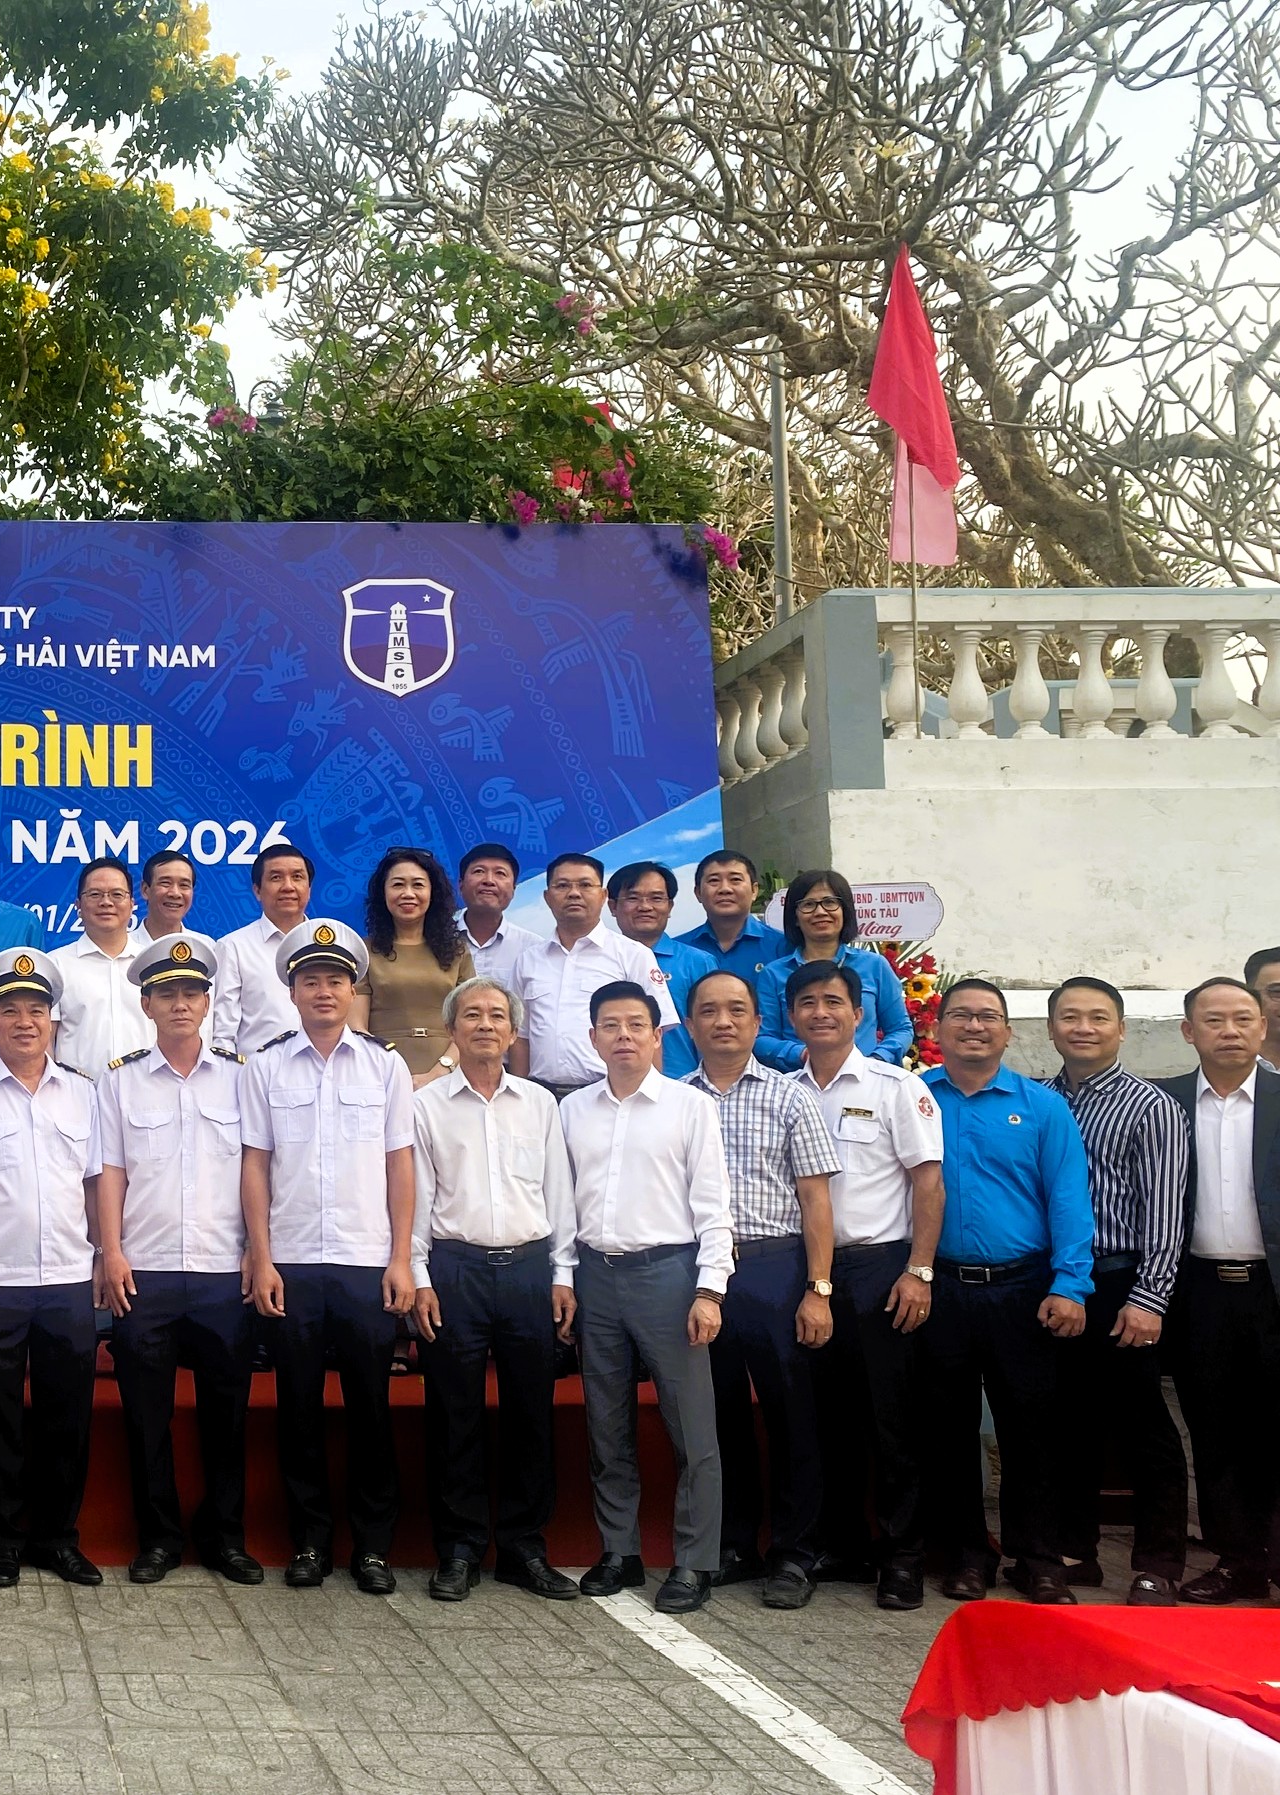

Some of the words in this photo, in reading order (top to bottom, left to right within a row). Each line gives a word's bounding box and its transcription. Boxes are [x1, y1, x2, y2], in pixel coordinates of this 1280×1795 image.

[0, 606, 37, 629] TY
[16, 636, 66, 667] HẢI
[75, 638, 140, 675] VIỆT
[148, 645, 216, 668] NAM
[12, 808, 139, 864] NĂM
[855, 906, 877, 919] ŨNG
[879, 904, 899, 918] TÀU
